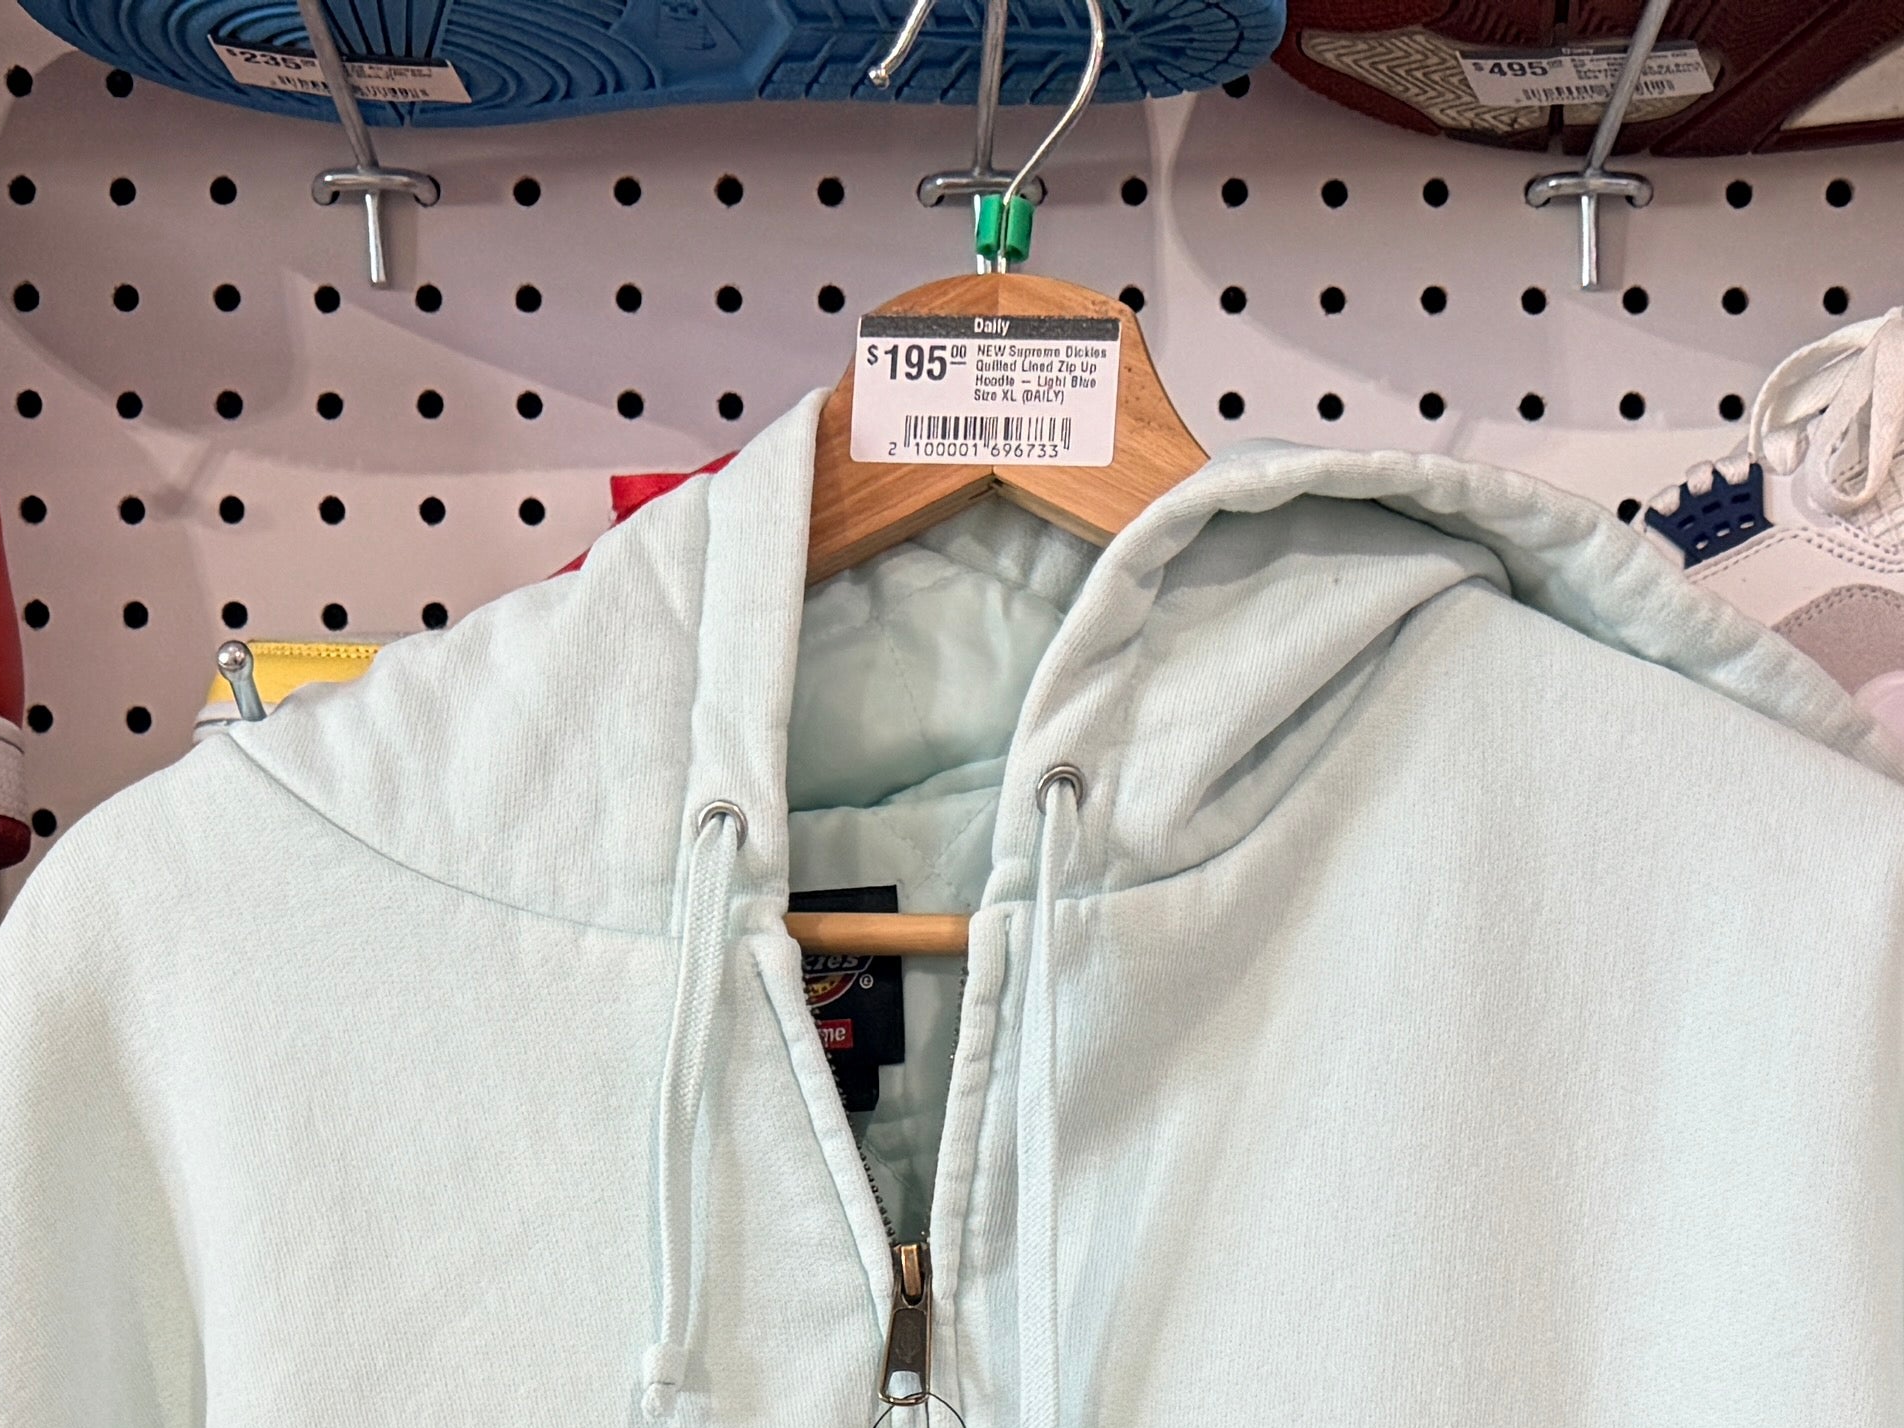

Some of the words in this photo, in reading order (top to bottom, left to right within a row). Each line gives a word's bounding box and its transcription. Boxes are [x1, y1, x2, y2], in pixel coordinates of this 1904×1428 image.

[974, 317, 1010, 337] Daily
[977, 344, 1006, 358] NEW
[1008, 344, 1061, 361] Supreme
[1065, 345, 1107, 359] Dickies
[1021, 360, 1053, 373] Lined
[1057, 360, 1077, 375] Zip
[1080, 361, 1097, 375] Up
[975, 374, 1015, 387] Hoodie
[1037, 375, 1066, 389] Light
[1071, 376, 1097, 389] Blue
[973, 388, 997, 401] Size
[1001, 389, 1017, 402] XL
[1022, 389, 1065, 405] (DAILY)
[888, 441, 898, 456] 2
[914, 442, 978, 457] 100001
[989, 443, 1059, 459] 696733
